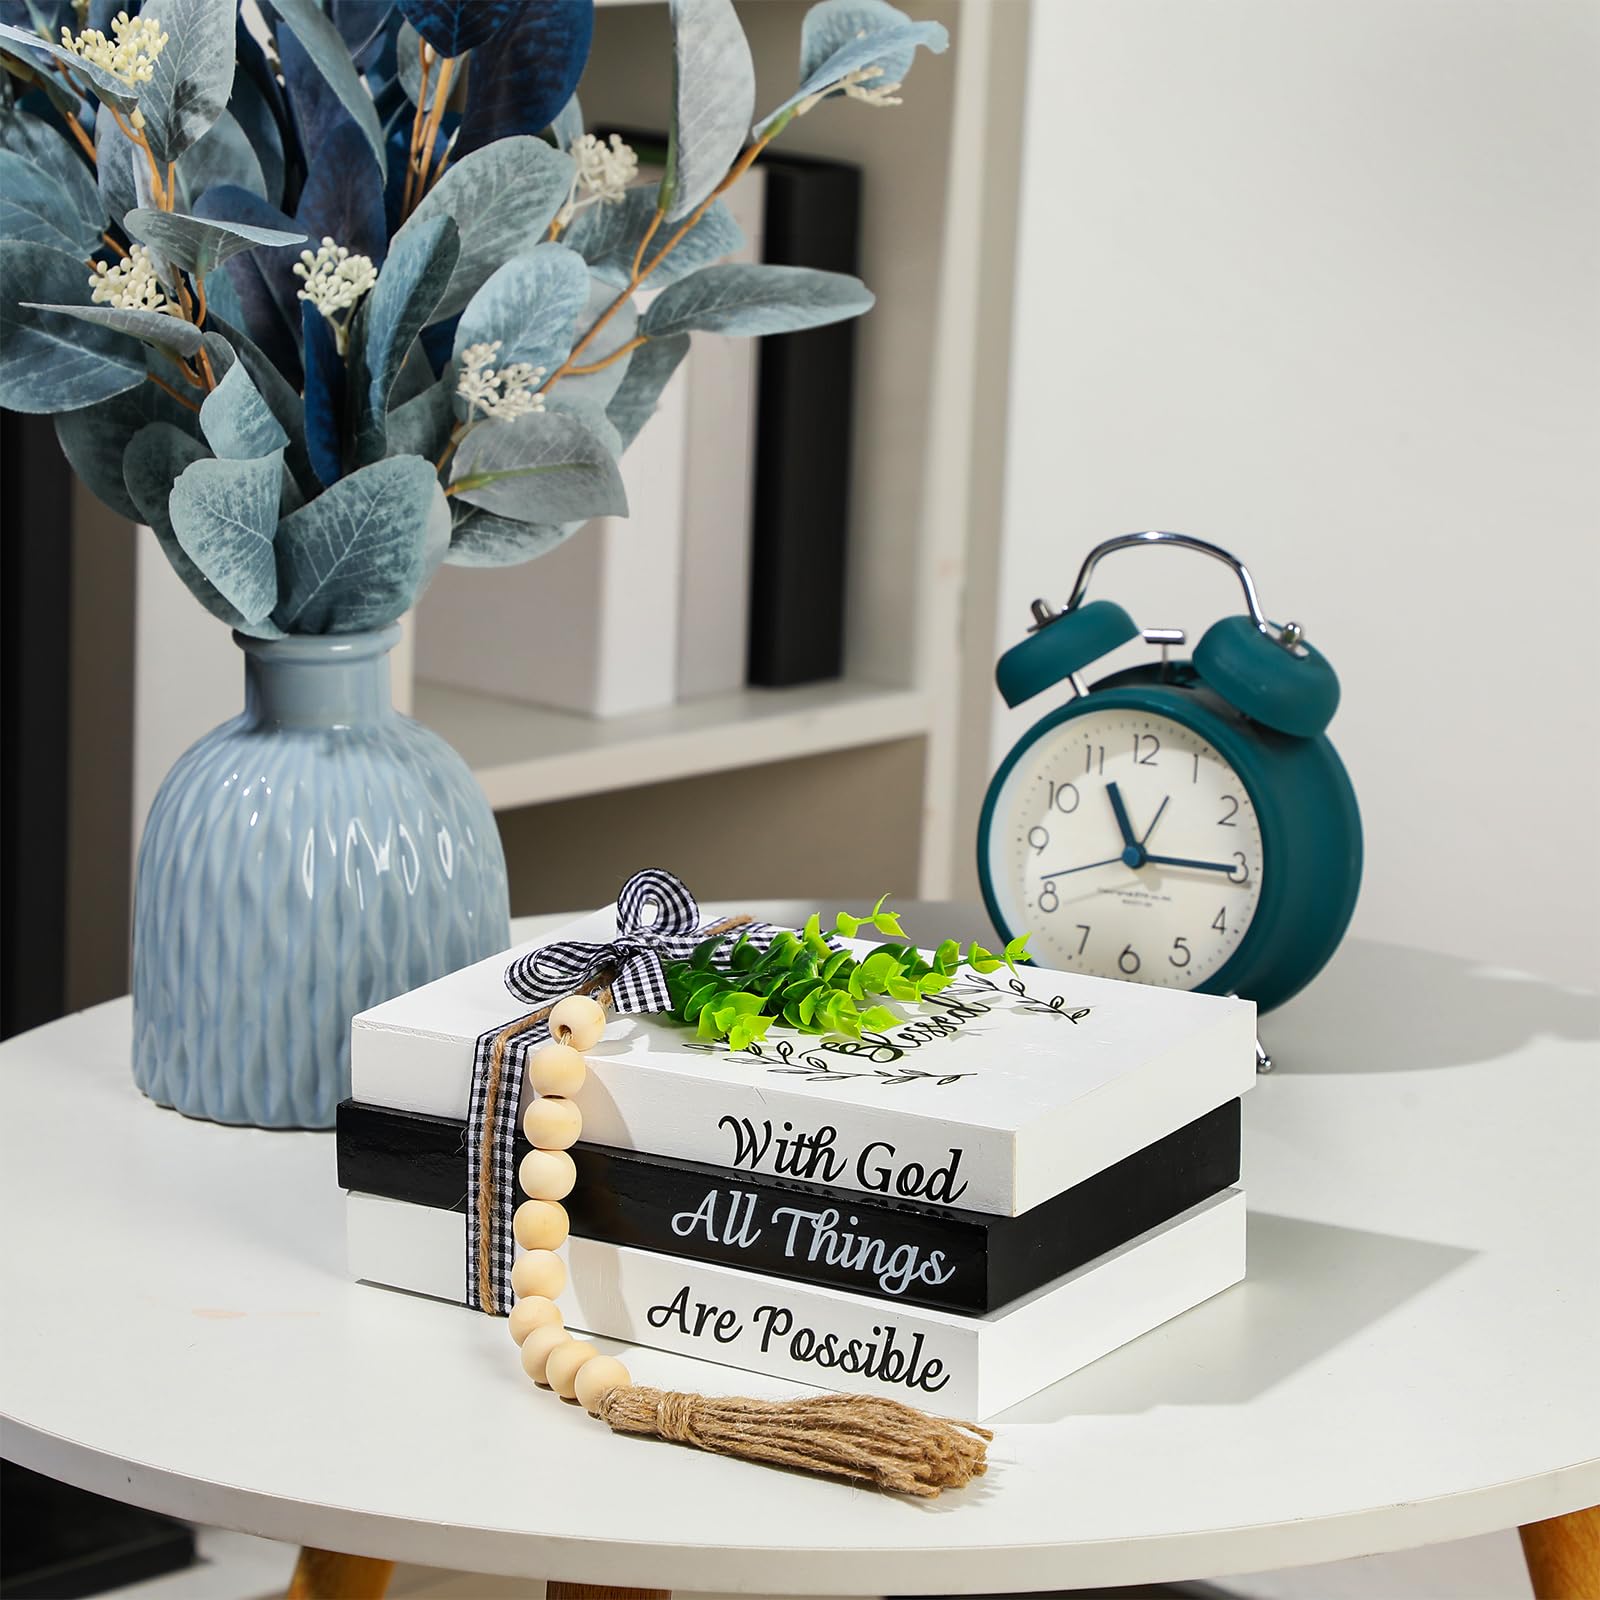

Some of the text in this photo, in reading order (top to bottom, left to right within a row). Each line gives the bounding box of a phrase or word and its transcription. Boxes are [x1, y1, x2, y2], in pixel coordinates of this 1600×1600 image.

[1086, 744, 1105, 776] 11
[1132, 733, 1161, 766] 12
[1192, 753, 1199, 784] 1
[1048, 780, 1080, 813] 10
[1217, 795, 1239, 826] 2
[1028, 826, 1050, 856] 9
[1227, 851, 1249, 884] 3
[1038, 881, 1059, 913] 8
[1211, 906, 1227, 935] 4
[1076, 925, 1091, 955] 7
[1169, 937, 1191, 967] 5
[1118, 944, 1141, 974] 6
[798, 993, 991, 1063] Blessed
[718, 1115, 969, 1204] With God
[671, 1189, 956, 1295] All Things
[646, 1286, 951, 1393] Are Possible
